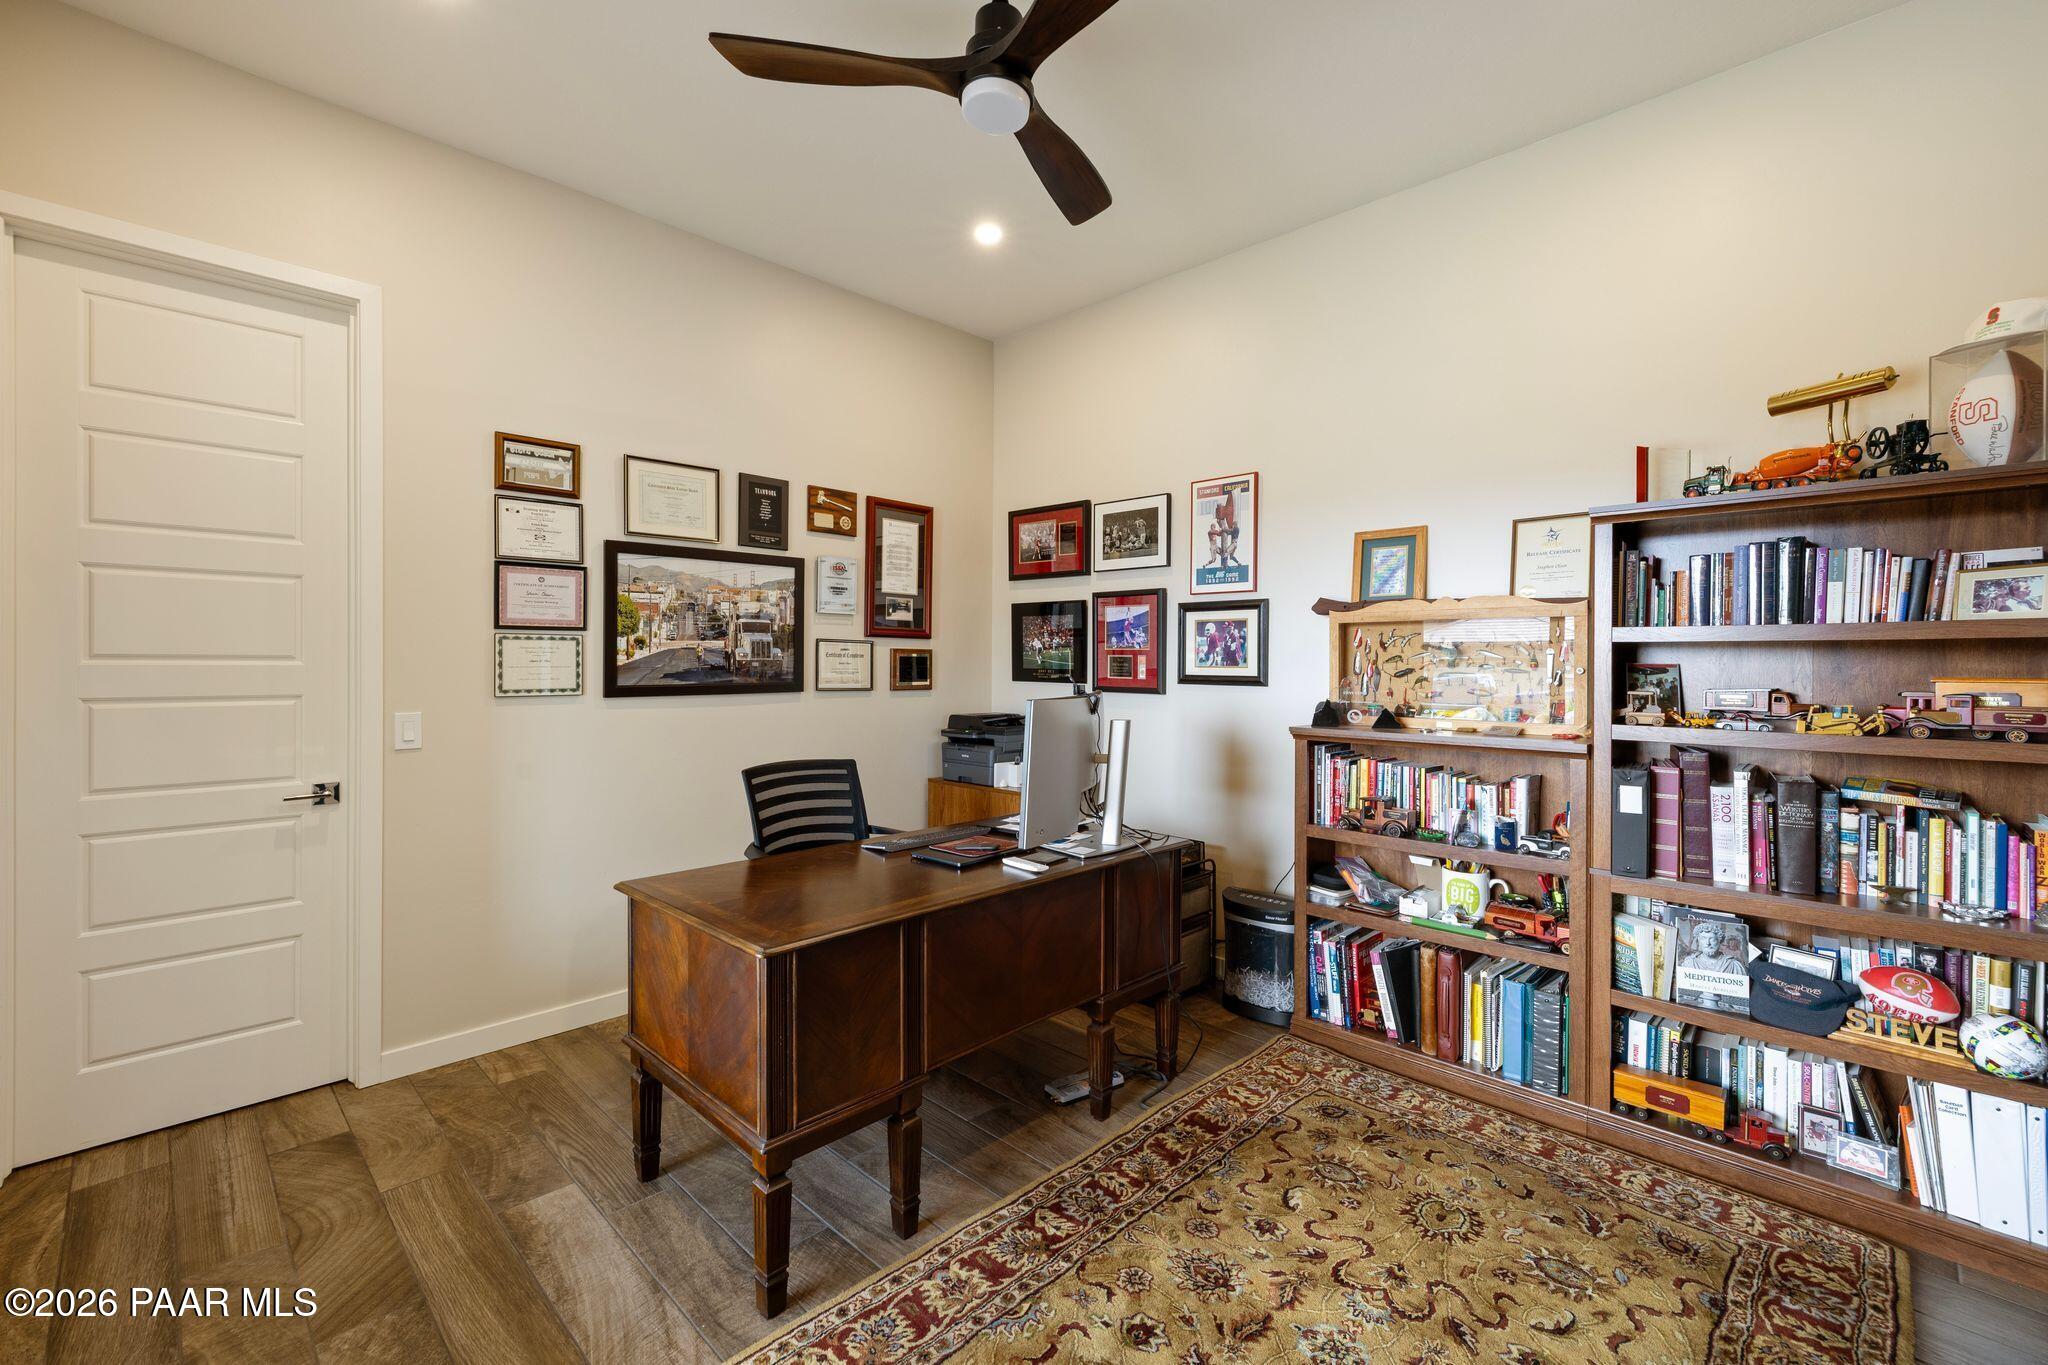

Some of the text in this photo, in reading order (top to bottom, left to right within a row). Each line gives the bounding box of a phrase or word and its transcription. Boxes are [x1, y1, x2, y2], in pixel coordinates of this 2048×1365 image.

[1986, 307, 2000, 326] S
[1950, 387, 1965, 446] STANFORD
[1958, 397, 1998, 426] S
[754, 487, 777, 497] TEAMWORK
[1200, 483, 1249, 496] STANFORD CALIFORNIA
[1549, 548, 1581, 556] CERTIFICATE
[1818, 553, 1828, 596] Cosmic Consciousness
[1860, 791, 1917, 806] JAMES PATTERSON
[1712, 793, 1720, 822] ASANAS
[1720, 794, 1732, 823] 2,100
[1779, 805, 1812, 813] WEBSTER'S
[1869, 830, 1877, 840] THIN
[1869, 841, 1877, 849] AIR
[2038, 832, 2046, 858] WORLD
[2038, 860, 2046, 875] WAR
[1450, 886, 1475, 903] BIG
[1315, 955, 1323, 974] CAR
[1622, 956, 1636, 967] SEA
[1329, 962, 1338, 980] STUFF
[1375, 967, 1384, 991] COMPLETE
[1683, 970, 1744, 987] MEDITATIONS
[1689, 982, 1739, 994] MARCUS AURELIUS
[1795, 984, 1823, 996] WOLVES
[2020, 968, 2029, 1000] CARTE BLANCHE
[1975, 979, 1986, 1010] CHOLESTEROL
[1866, 993, 1940, 1026] 49ERS
[1845, 1006, 1959, 1055] STEVE
[1671, 1042, 1679, 1058] English
[1852, 1078, 1861, 1093] DAVE
[1856, 1091, 1868, 1114] RAMSEY
[1939, 1099, 1964, 1108] Baseball
[1937, 1107, 1968, 1118] Collection
